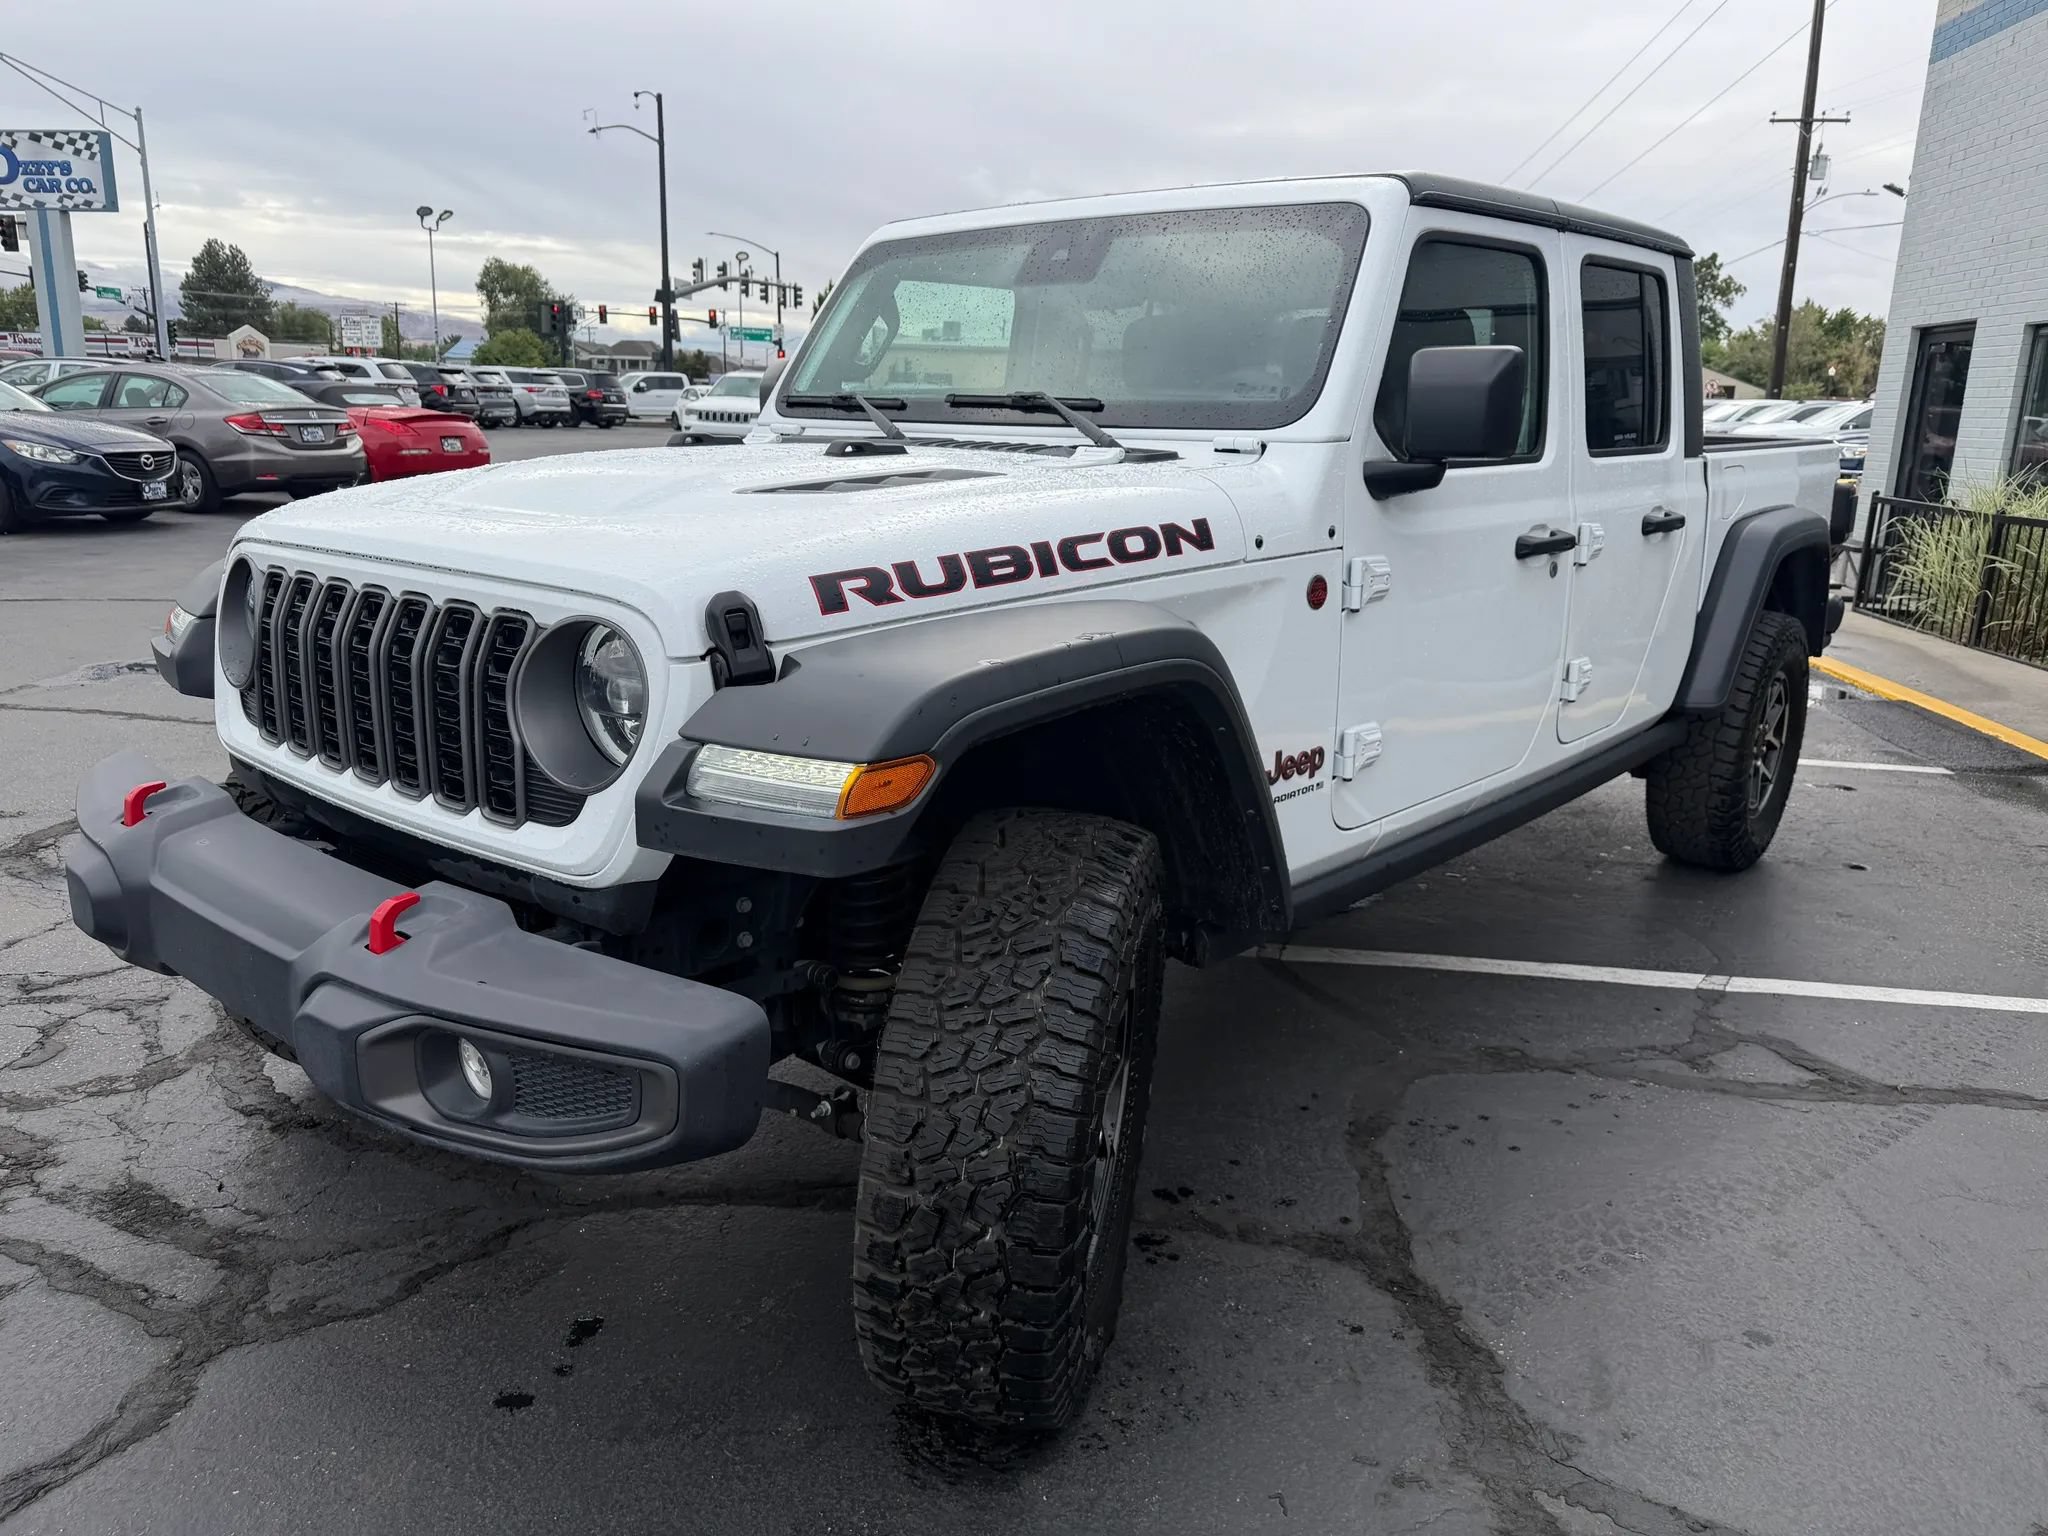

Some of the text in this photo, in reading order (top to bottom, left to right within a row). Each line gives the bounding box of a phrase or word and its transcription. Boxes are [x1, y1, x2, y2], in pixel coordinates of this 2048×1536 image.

[23, 177, 97, 194] CAR CO.
[808, 517, 1215, 616] RUBICON
[1265, 745, 1325, 786] Jeep
